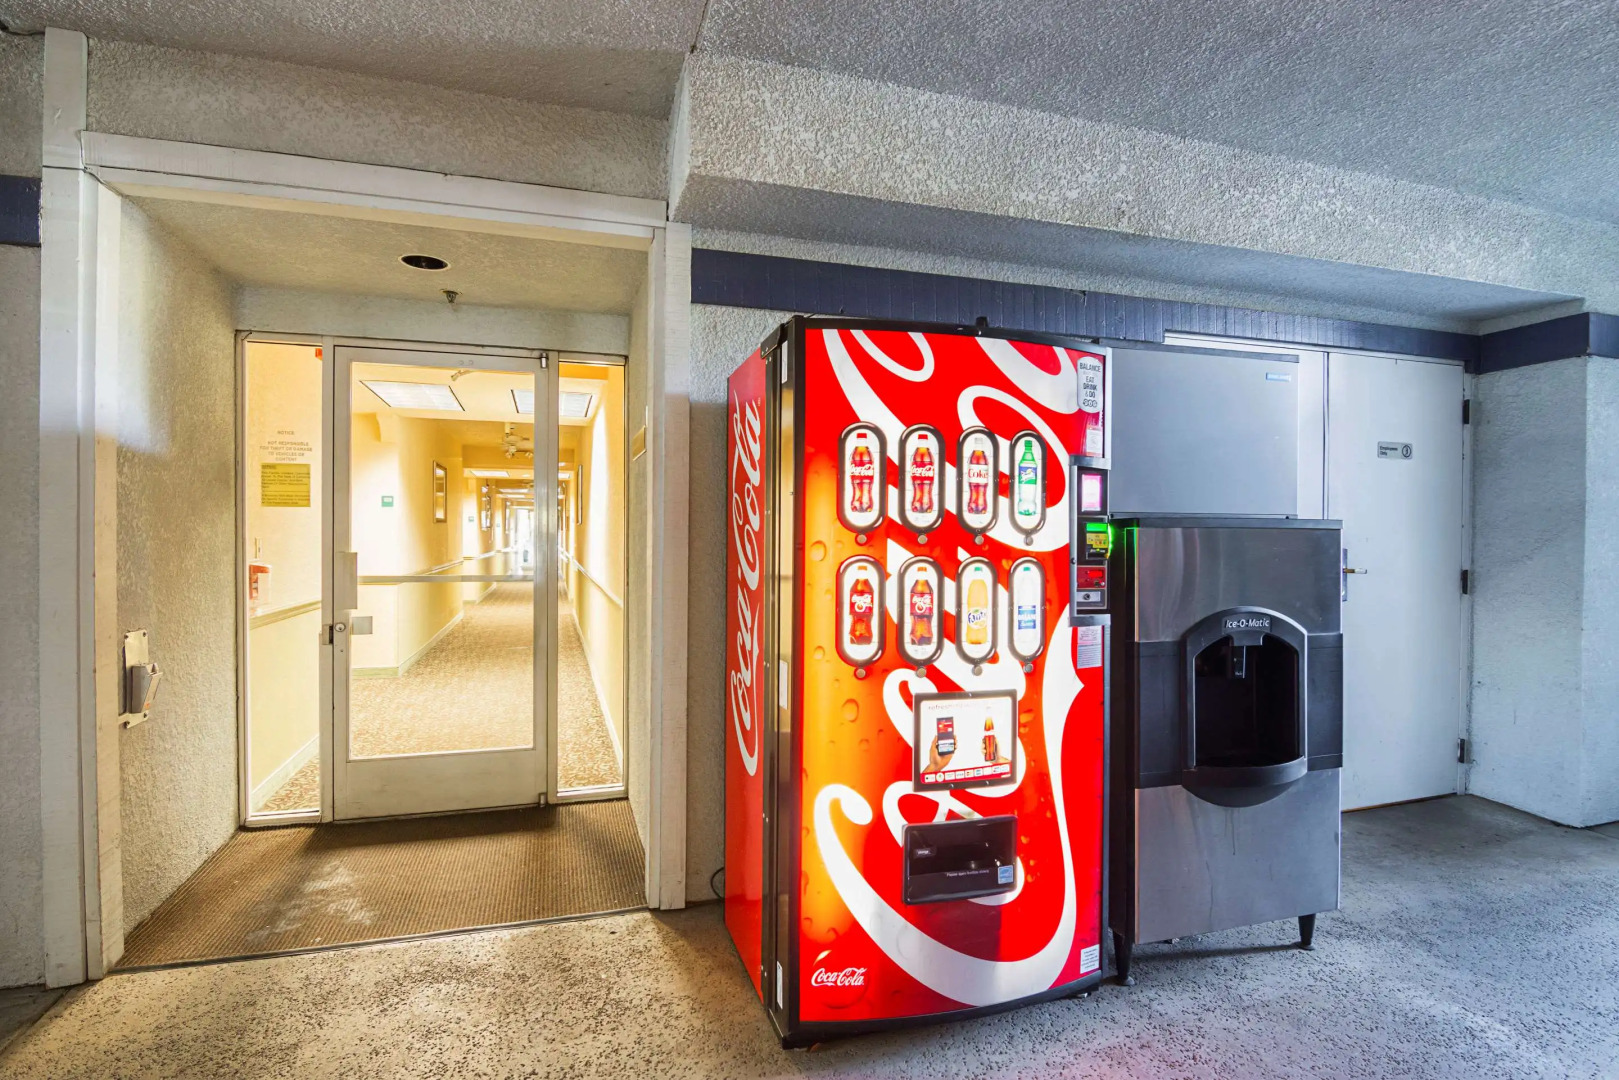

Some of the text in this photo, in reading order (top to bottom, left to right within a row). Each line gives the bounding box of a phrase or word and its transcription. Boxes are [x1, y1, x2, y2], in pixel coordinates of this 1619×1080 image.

[1079, 362, 1101, 373] BALANCE
[1085, 376, 1095, 384] EAT
[731, 389, 760, 777] Coca-Cola
[1225, 618, 1270, 628] Ice-O-Matic
[811, 967, 868, 987] Coca-Cola
